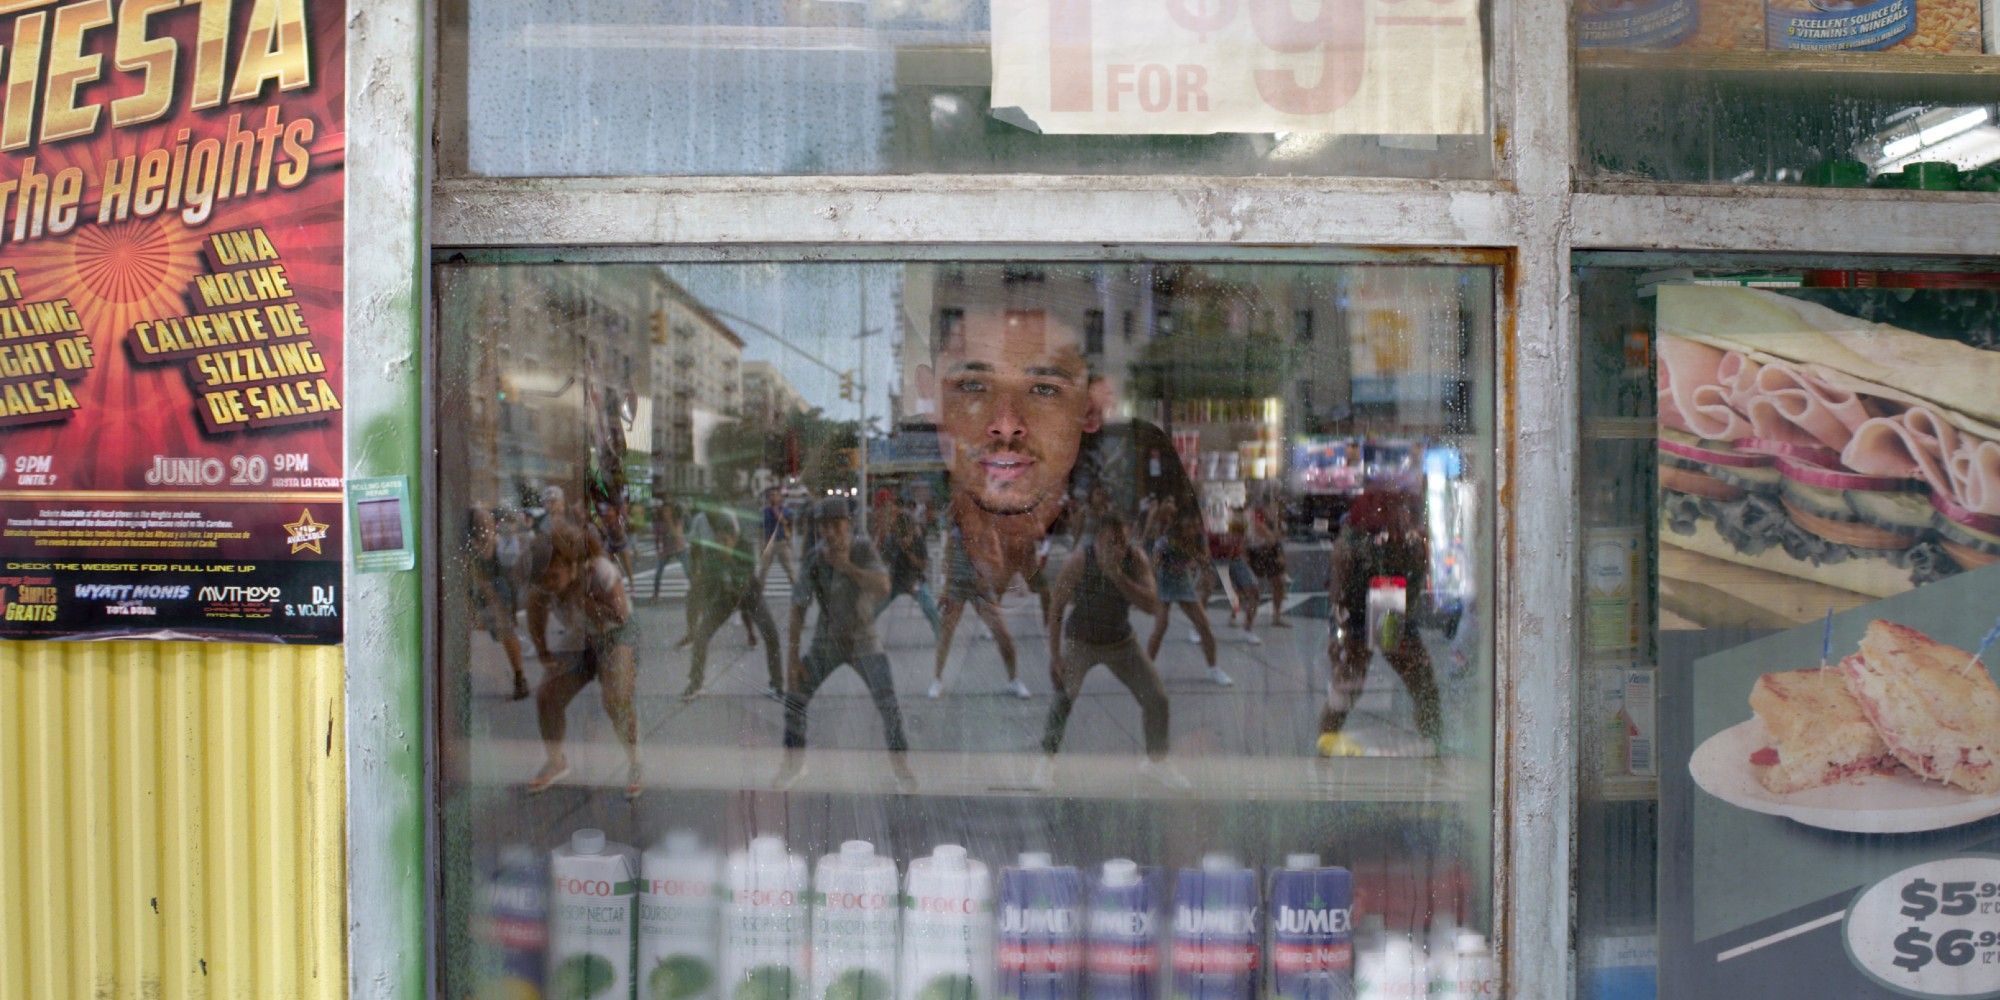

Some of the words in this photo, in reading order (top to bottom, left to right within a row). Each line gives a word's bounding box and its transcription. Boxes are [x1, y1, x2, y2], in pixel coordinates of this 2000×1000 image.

[1791, 18, 1850, 29] EXCELLENT
[1850, 8, 1889, 26] SOURCE
[1890, 0, 1904, 14] OF
[1796, 26, 1849, 40] VITAMINS
[1850, 26, 1858, 36] &
[1859, 6, 1909, 34] MINERALS
[0, 0, 311, 152] IESTA
[1106, 64, 1210, 112] FOR
[209, 227, 281, 266] UNA
[194, 263, 295, 308] NOCHE
[135, 308, 270, 354] CALIENTE
[263, 302, 311, 339] DE
[54, 335, 95, 371] OF
[196, 340, 327, 387] SIZZLING
[0, 377, 82, 418] ALSA
[205, 389, 250, 426] DE
[245, 379, 343, 422] SALSA
[15, 455, 53, 473] 9PM
[229, 455, 268, 487] 20
[274, 453, 309, 472] 9PM
[6, 562, 52, 571] CHECK
[53, 563, 80, 571] THE
[81, 563, 139, 572] WEBSITE
[141, 564, 168, 572] FOR
[170, 564, 204, 573] FULL
[206, 564, 235, 573] LINE
[237, 565, 256, 573] UP
[75, 584, 133, 601] WYATT
[132, 585, 190, 600] MONIS
[312, 586, 334, 605] DJ
[6, 602, 58, 622] GRATIS
[285, 604, 296, 616] S.
[556, 878, 611, 897] FOCO
[587, 905, 625, 923] NECTAR
[1174, 904, 1259, 934] JUMEX
[1274, 904, 1354, 934] JUMEX
